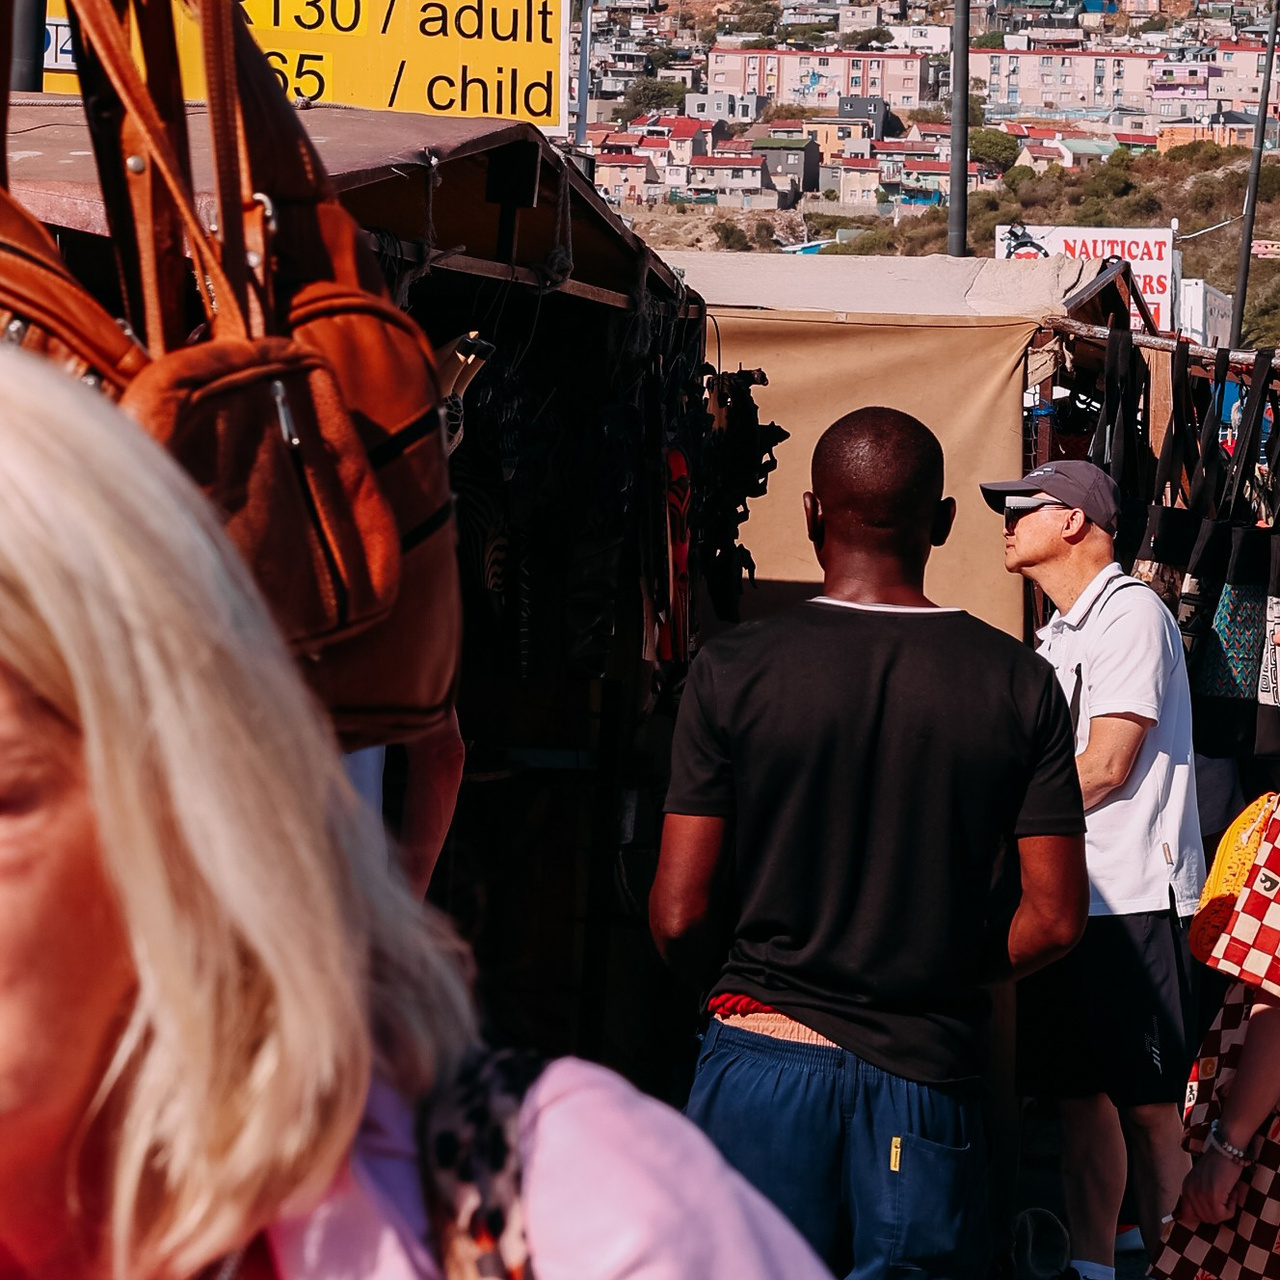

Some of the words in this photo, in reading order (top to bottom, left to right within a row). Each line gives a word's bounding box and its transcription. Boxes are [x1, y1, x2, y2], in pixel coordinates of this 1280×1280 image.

[388, 60, 406, 107] /
[427, 64, 553, 117] child
[1063, 239, 1167, 261] NAUTICAT
